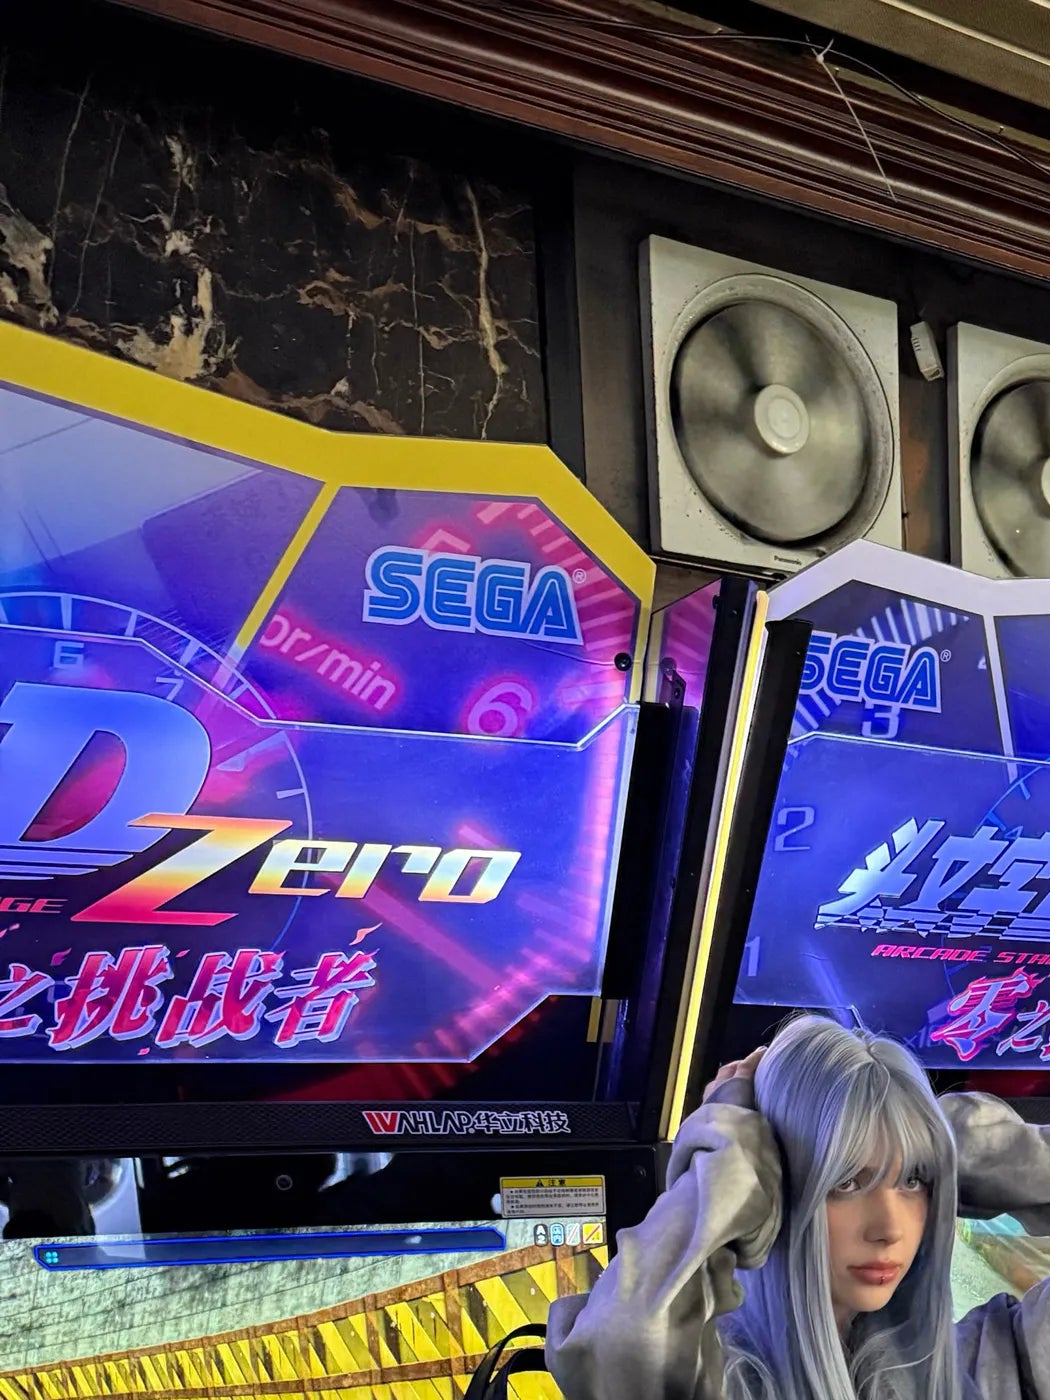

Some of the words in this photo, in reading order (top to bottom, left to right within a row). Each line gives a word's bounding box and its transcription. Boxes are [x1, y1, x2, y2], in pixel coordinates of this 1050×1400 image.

[362, 545, 585, 645] SEGA
[800, 630, 942, 714] SEGA
[774, 806, 816, 852] 2
[71, 812, 523, 926] Zero
[871, 944, 988, 964] ARCADE
[362, 1111, 472, 1135] WAHLAP
[473, 1110, 572, 1134] 华立科技
